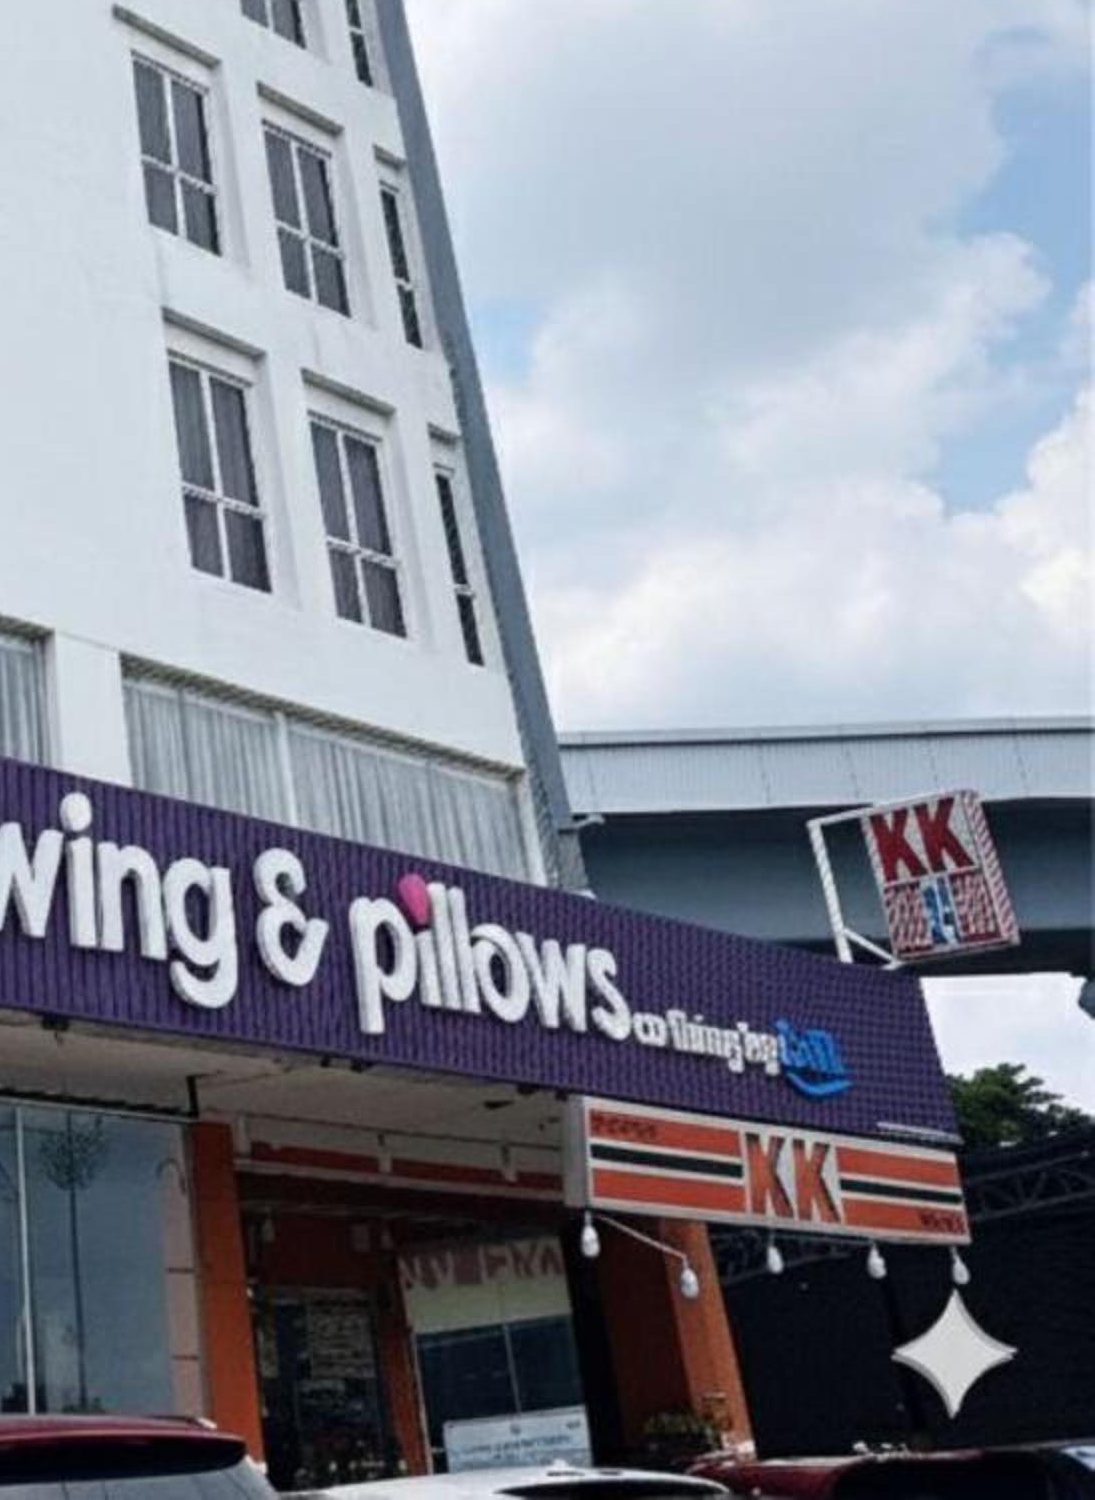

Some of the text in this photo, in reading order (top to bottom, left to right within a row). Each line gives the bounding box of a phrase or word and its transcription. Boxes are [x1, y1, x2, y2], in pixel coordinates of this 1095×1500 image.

[869, 797, 975, 884] KK
[253, 847, 329, 986] &
[348, 873, 632, 1040] pillows
[746, 1132, 841, 1224] KK
